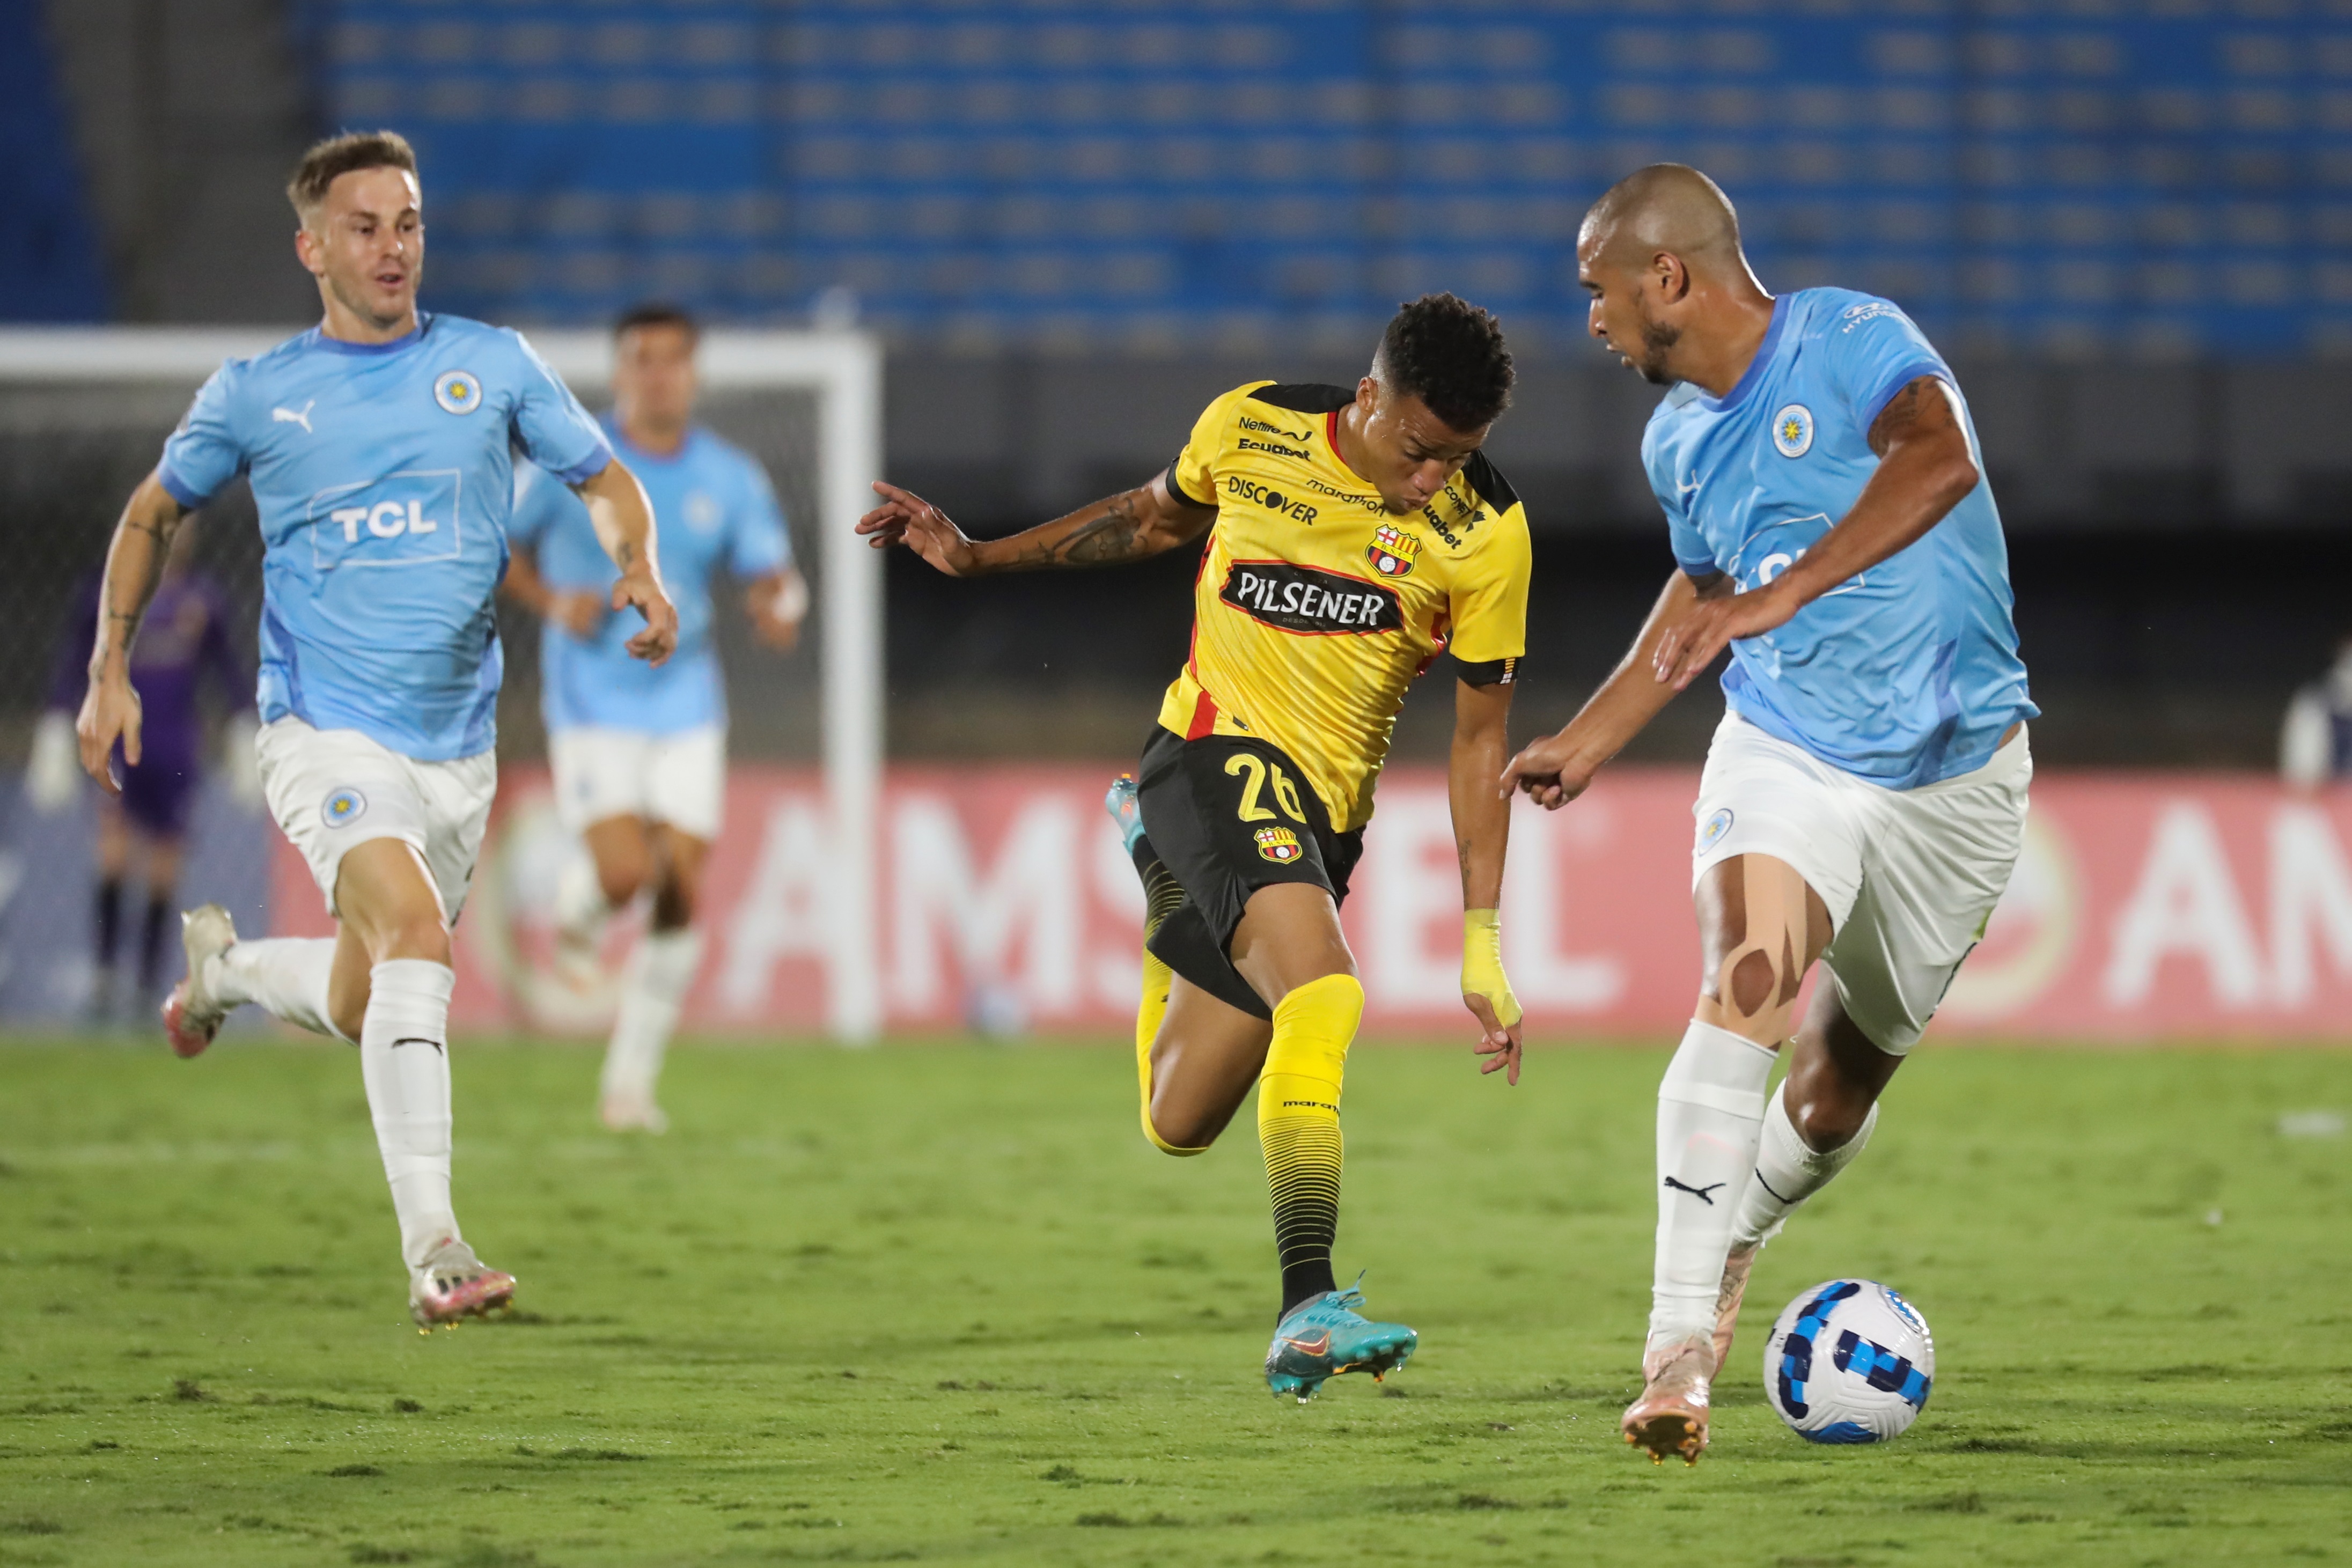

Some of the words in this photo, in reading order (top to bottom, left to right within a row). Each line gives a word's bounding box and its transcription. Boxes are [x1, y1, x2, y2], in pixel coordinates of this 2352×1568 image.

[1237, 438, 1311, 462] Ecuabet
[330, 499, 438, 542] TCL
[1228, 475, 1318, 526] DISCOVER
[1306, 479, 1385, 517] marathon
[1423, 504, 1462, 550] uabet
[1237, 571, 1385, 627] PILSENER
[1224, 753, 1307, 825] 26
